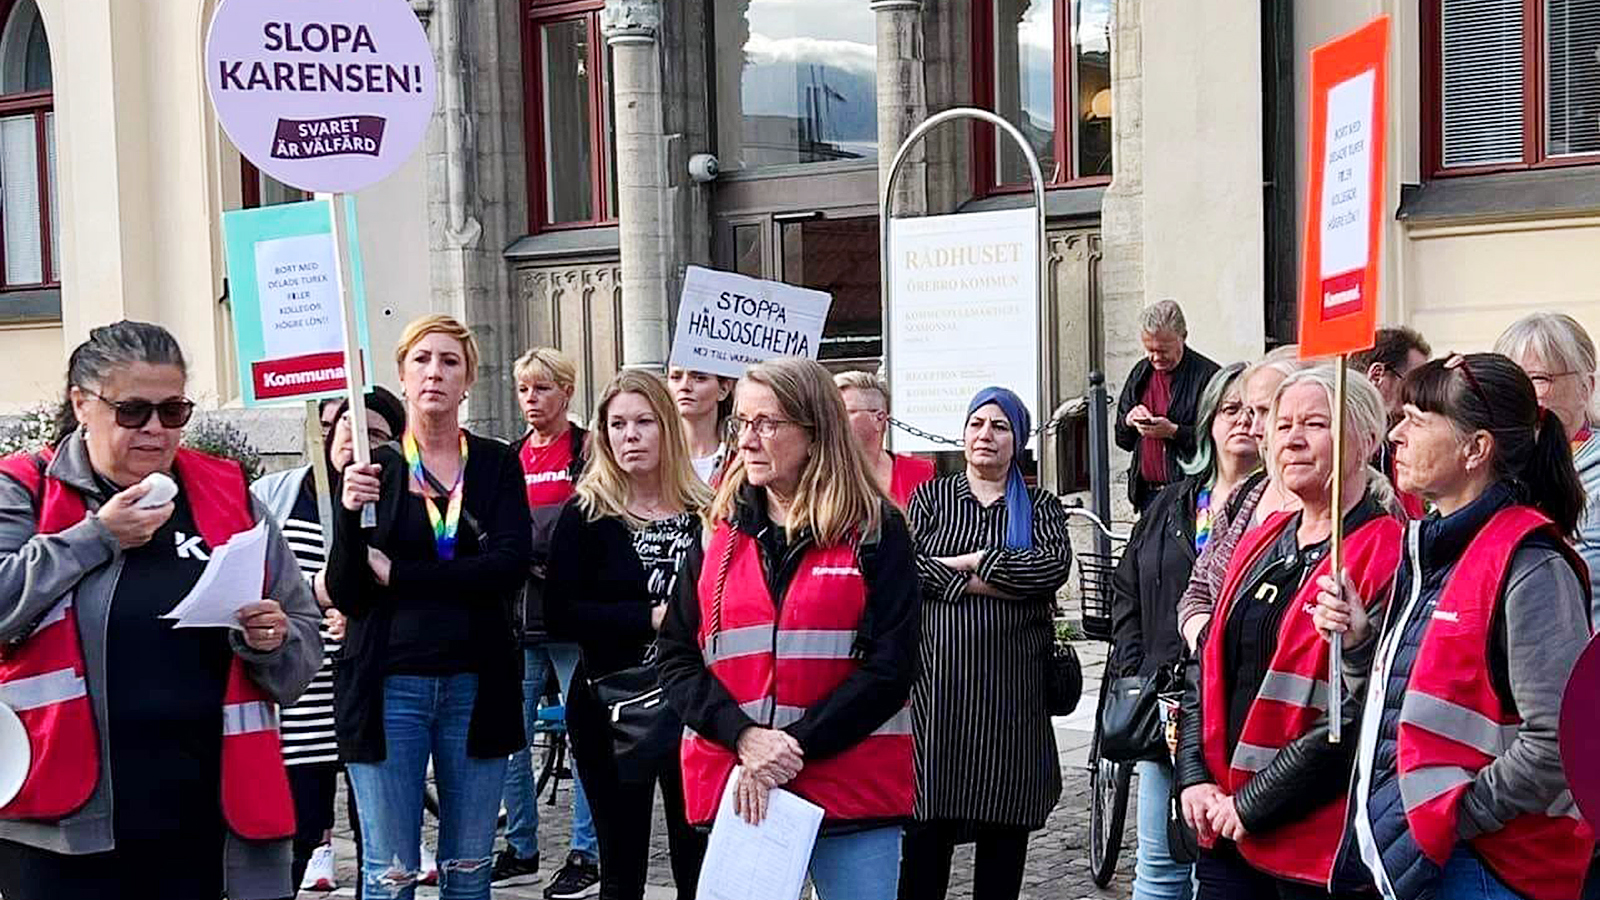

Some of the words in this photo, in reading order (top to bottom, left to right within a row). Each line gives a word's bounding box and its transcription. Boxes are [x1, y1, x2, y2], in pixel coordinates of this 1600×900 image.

[264, 22, 377, 53] SLOPA
[219, 60, 422, 93] KARENSEN!
[298, 118, 360, 138] SVARET
[276, 139, 301, 157] ÄR
[302, 134, 376, 155] VÄLFÄRD
[905, 241, 1023, 270] RÅDHUSET
[275, 264, 297, 275] BORT
[298, 261, 319, 272] MED
[268, 278, 299, 290] DELADE
[907, 278, 957, 292] ÖREBRO
[960, 275, 1019, 290] KOMMUN
[287, 291, 310, 301] FLER
[279, 302, 322, 315] KOLLEGOR
[717, 291, 787, 325] STOPPA
[274, 318, 304, 329] HÖGRE
[688, 307, 809, 358] HÄLSOSCHEMA
[710, 349, 728, 361] TILL
[174, 531, 211, 560] K
